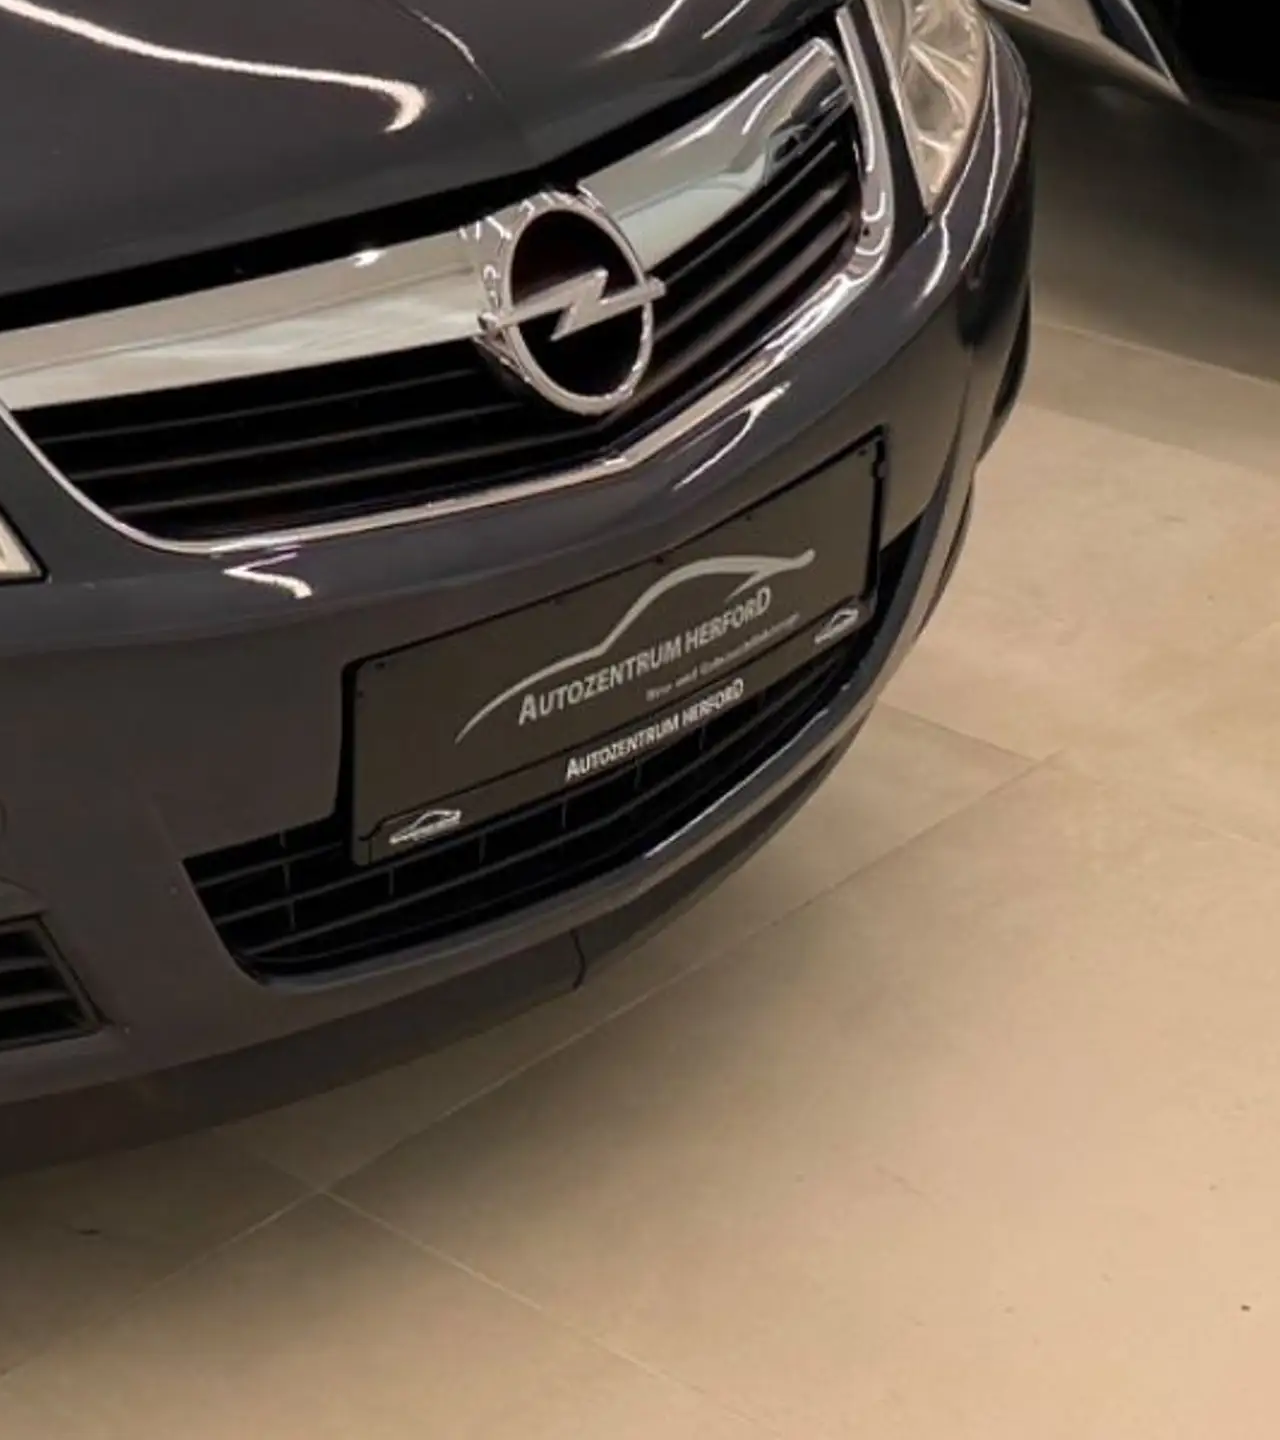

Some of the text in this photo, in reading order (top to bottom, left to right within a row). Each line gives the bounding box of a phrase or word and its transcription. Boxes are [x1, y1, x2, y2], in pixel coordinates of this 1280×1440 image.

[518, 635, 683, 726] AUTOZENTRUM
[685, 586, 772, 653] HERFORD
[566, 676, 745, 780] AUTOZENTRUM HERFORD
